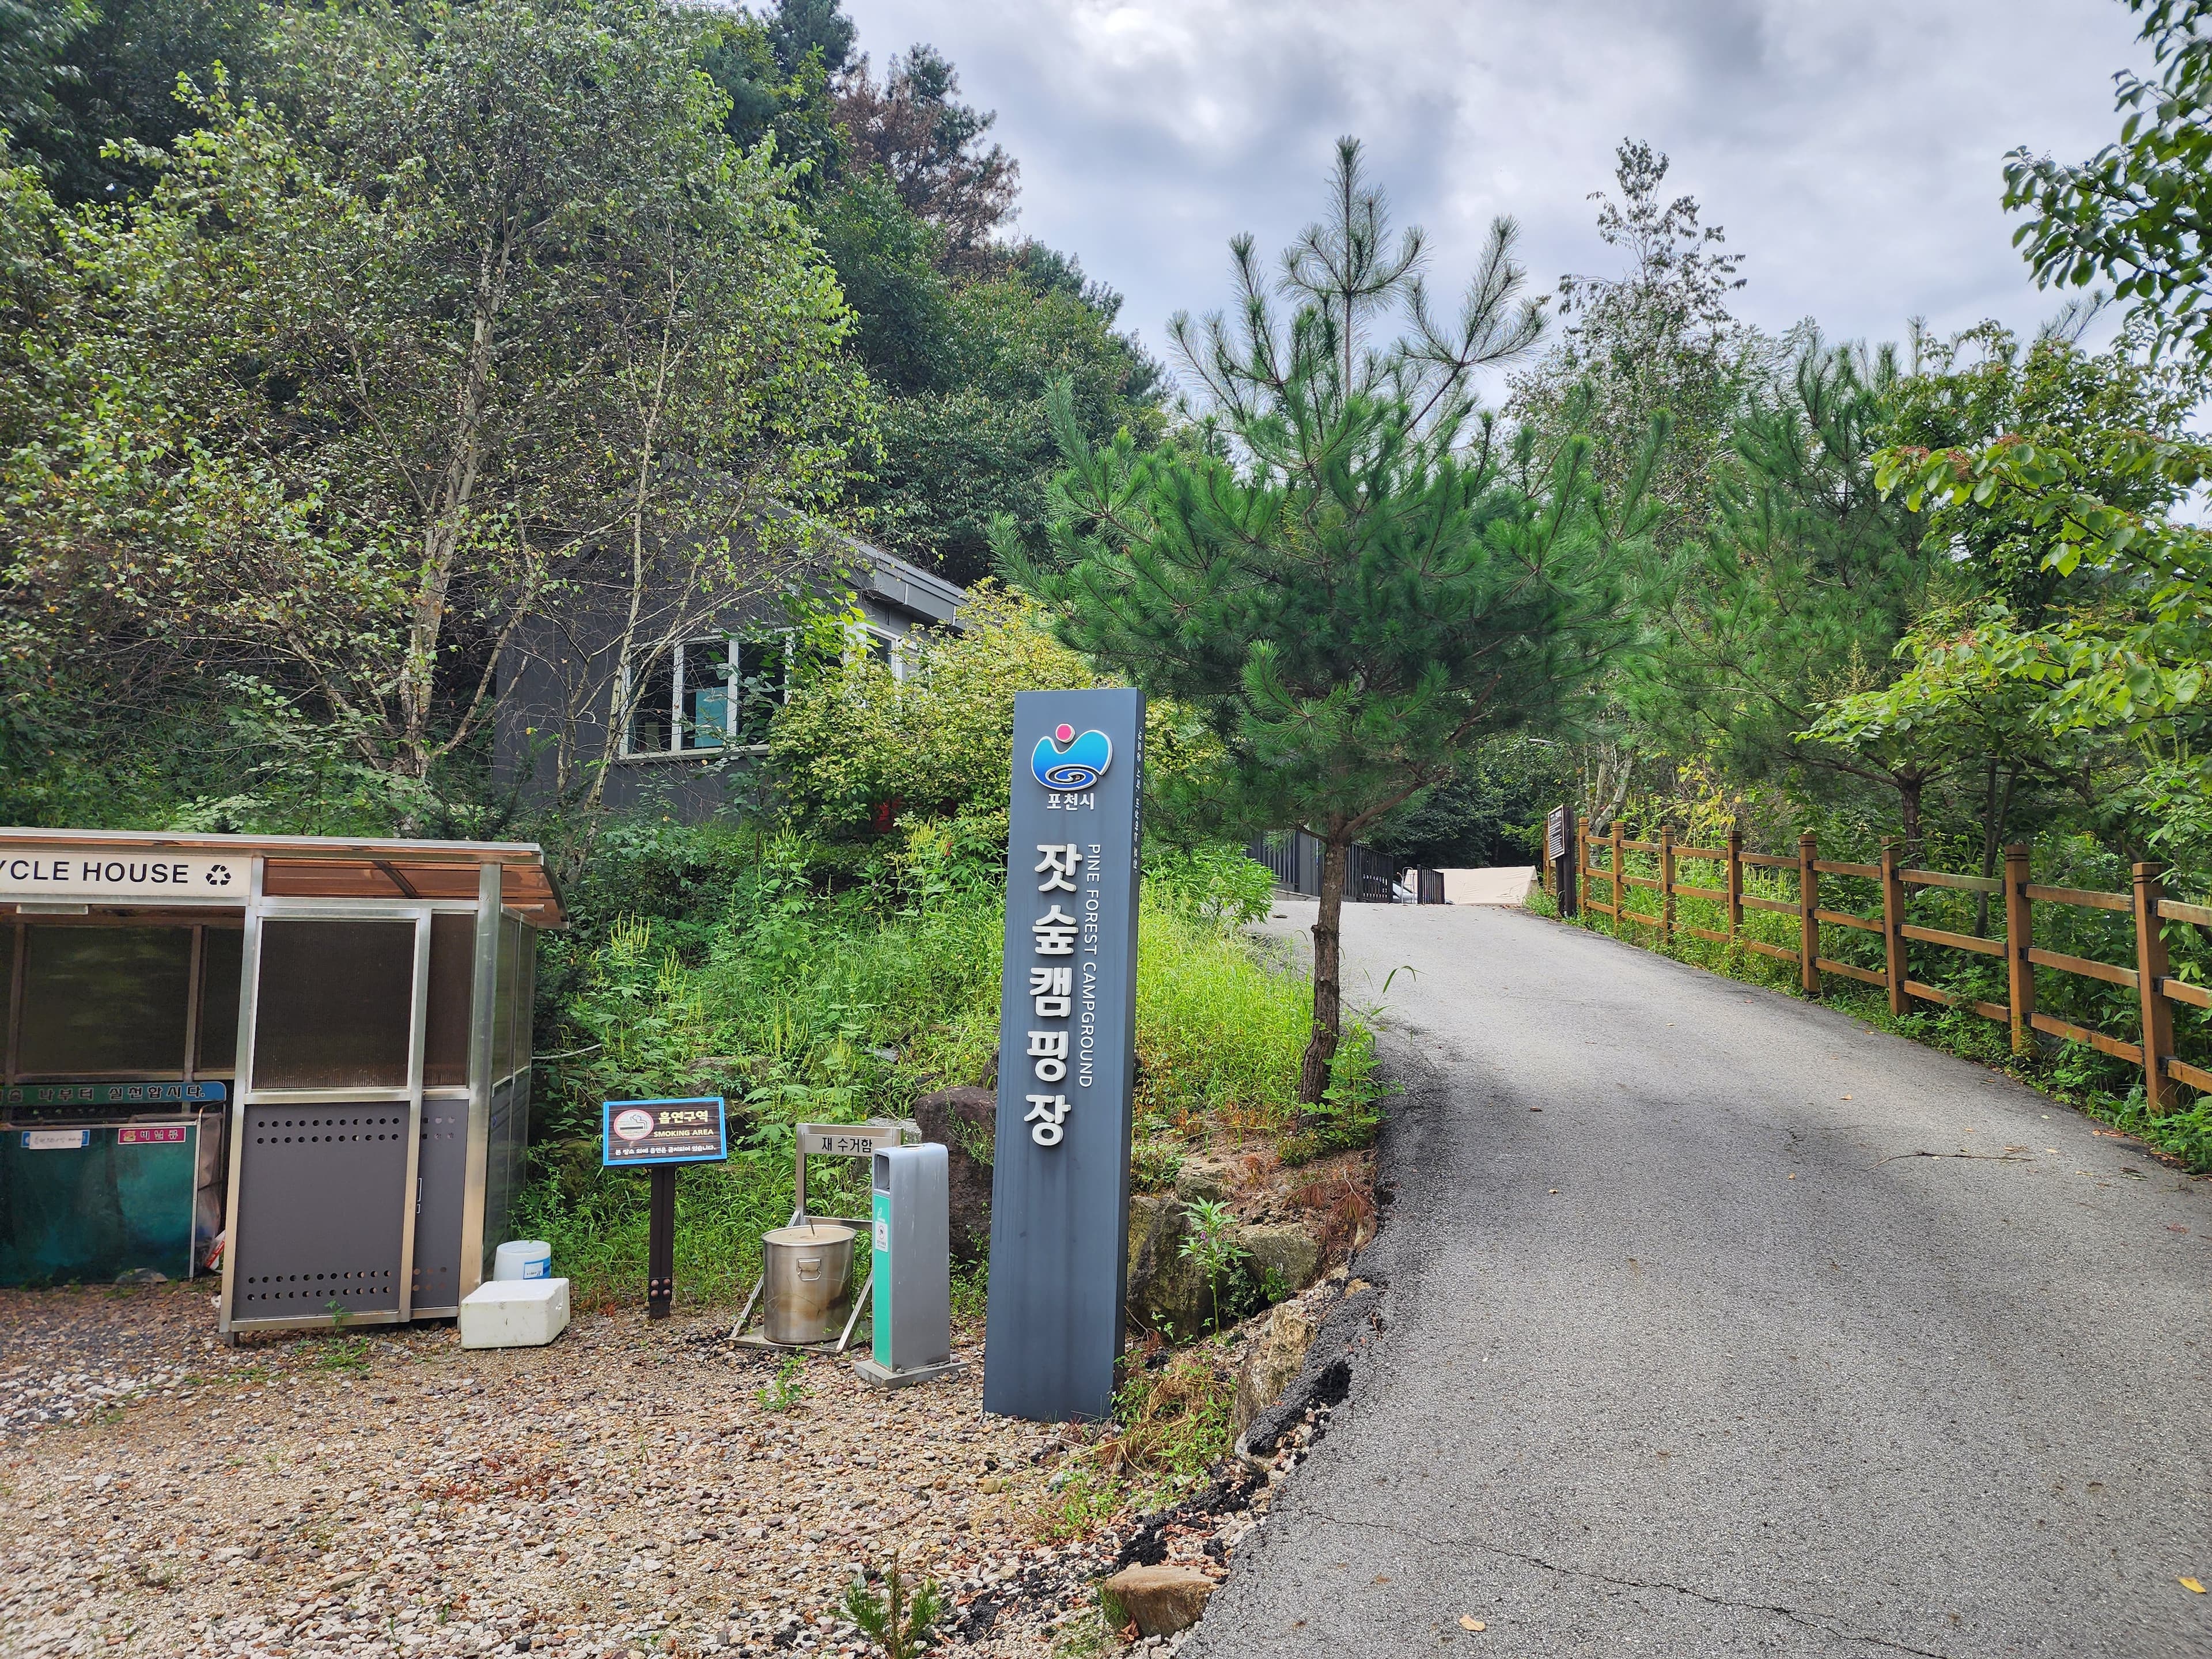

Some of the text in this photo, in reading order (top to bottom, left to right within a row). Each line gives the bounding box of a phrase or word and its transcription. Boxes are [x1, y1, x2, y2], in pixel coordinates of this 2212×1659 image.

[1047, 793, 1094, 810] 포천시
[83, 862, 189, 883] HOUSE
[1079, 844, 1101, 1088] PINE FOREST CAMPGROUND
[39, 1087, 94, 1102] 나부터
[108, 1085, 206, 1100] 실천합시다.
[658, 1110, 709, 1124] 흡연구역
[140, 1129, 179, 1141] 비닐류
[821, 1137, 872, 1153] 재 수거함
